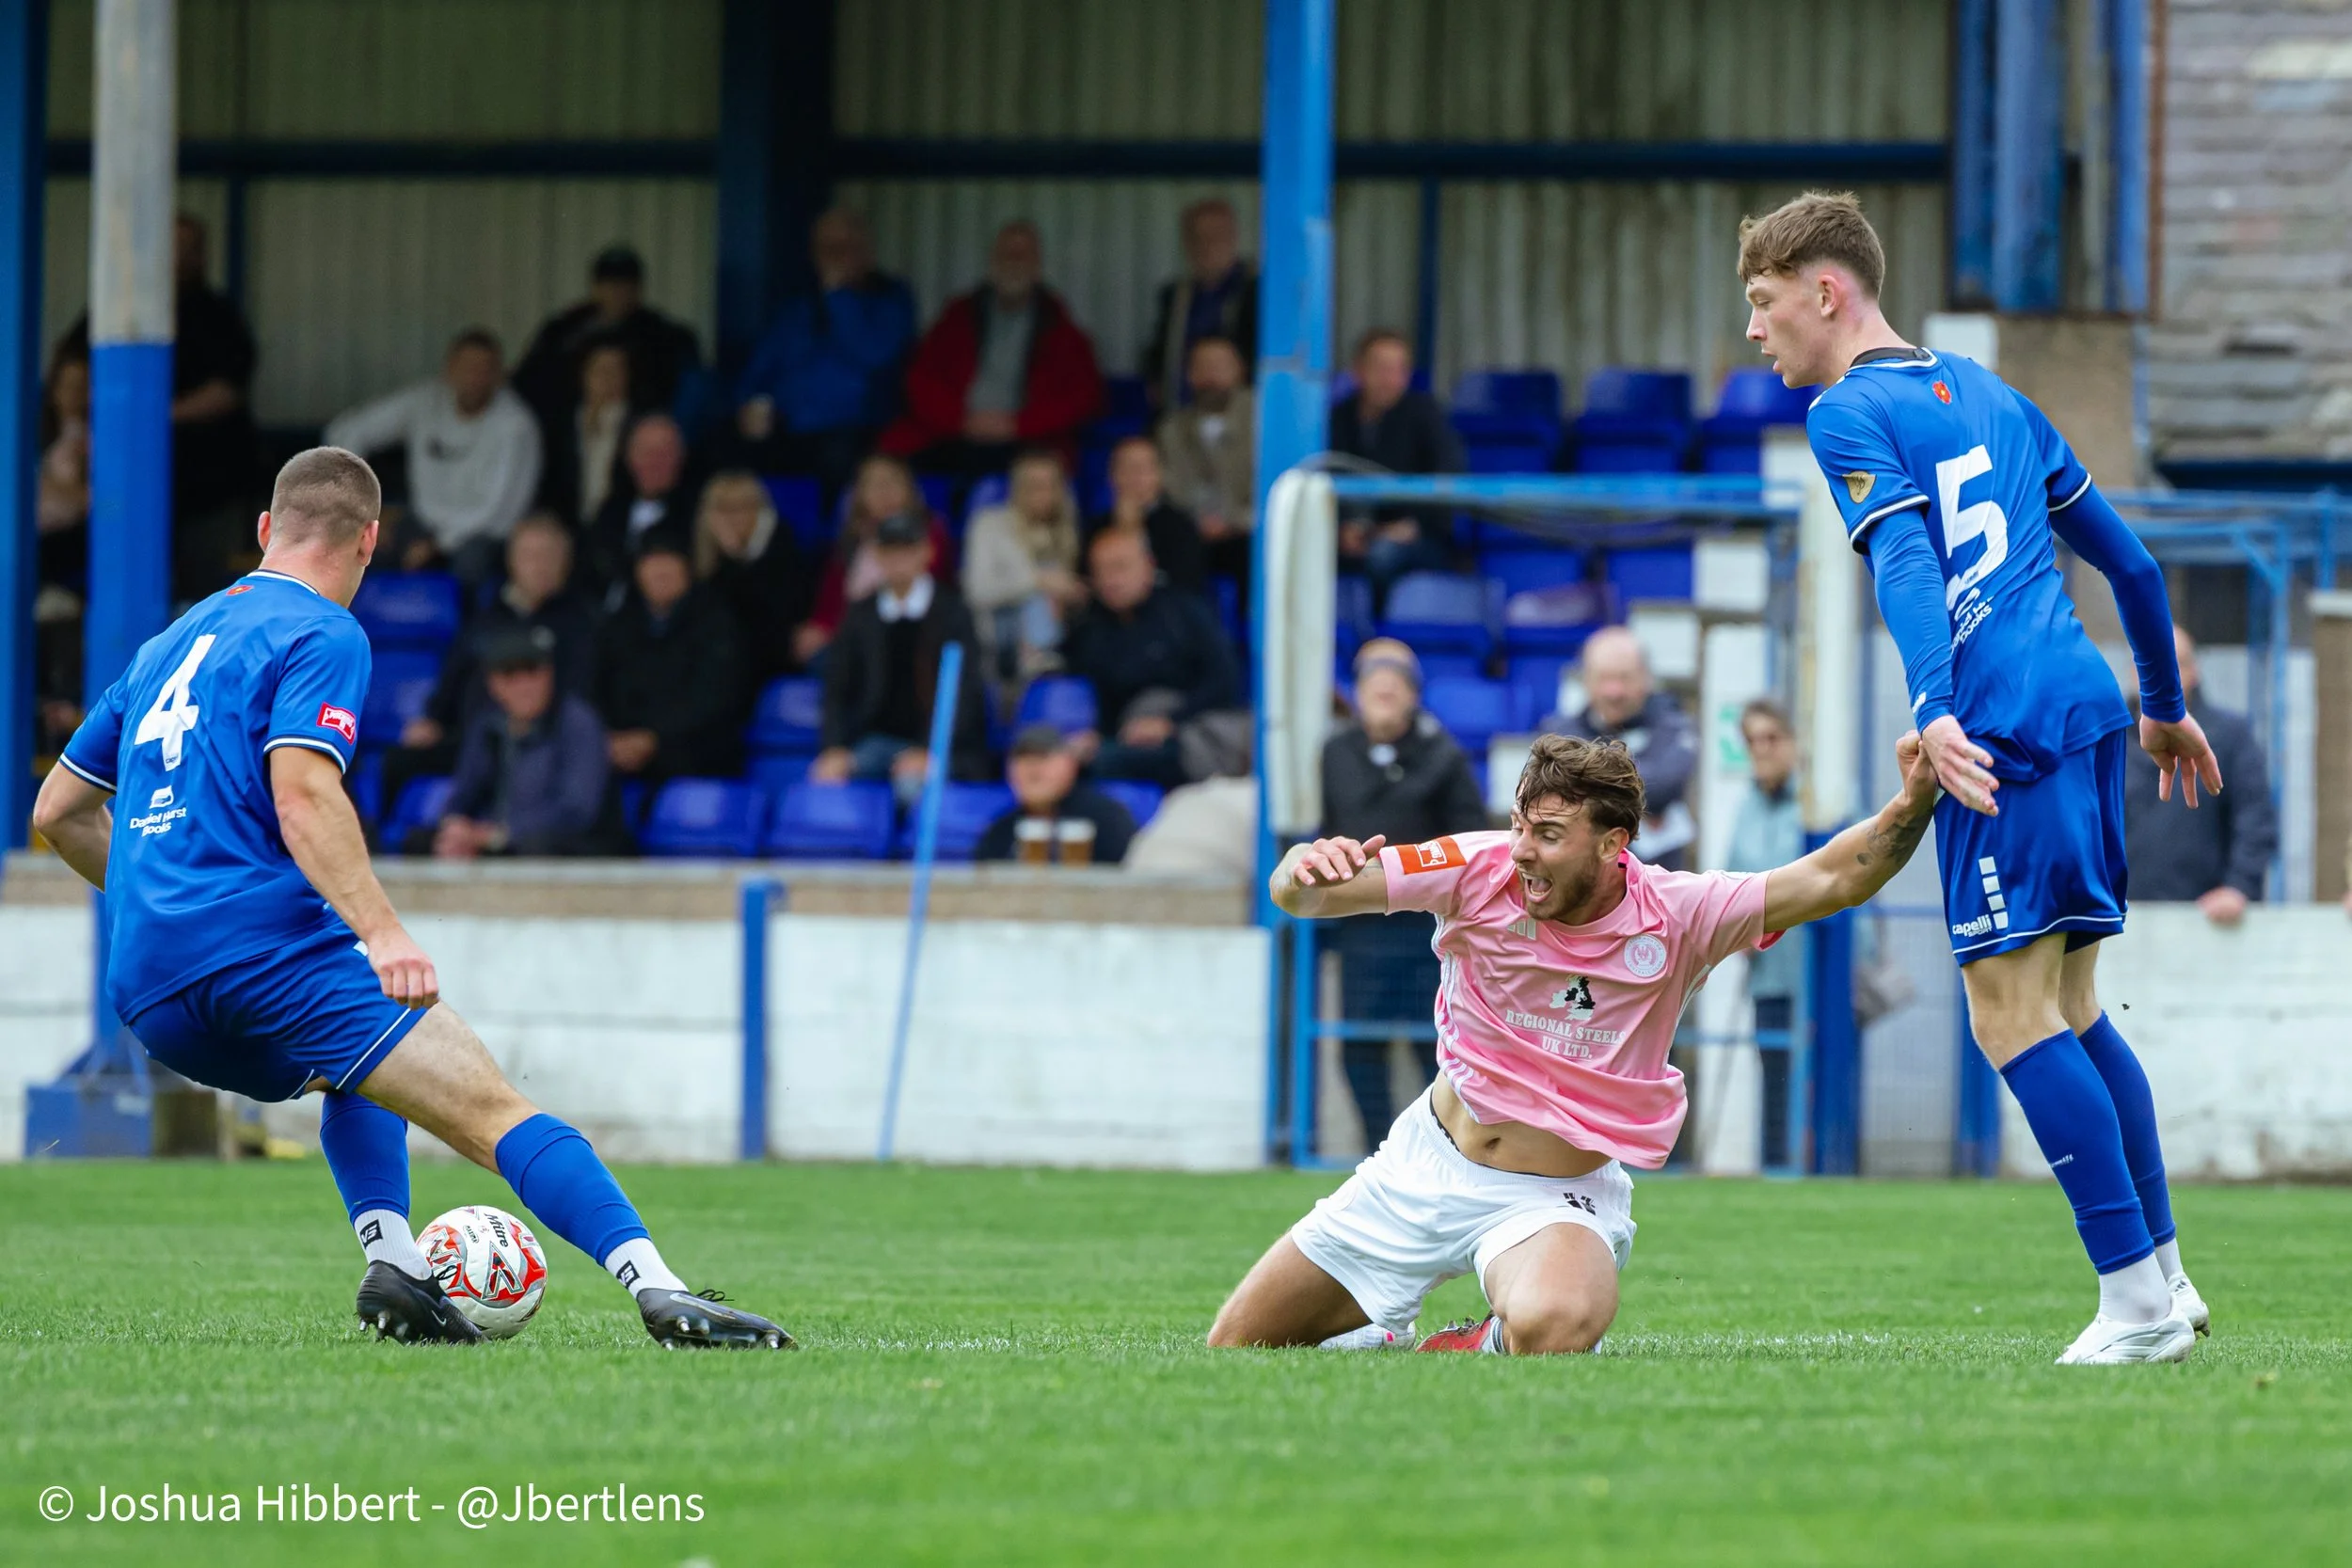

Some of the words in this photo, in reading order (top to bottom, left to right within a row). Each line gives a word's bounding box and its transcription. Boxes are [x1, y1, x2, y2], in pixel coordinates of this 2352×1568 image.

[1935, 444, 2009, 611] 5
[135, 634, 216, 772] 4
[1952, 913, 1992, 937] capelli
[1505, 1009, 1572, 1037] REGIONAL
[1575, 1026, 1627, 1044] STEELS
[1542, 1036, 1561, 1054] UK
[1563, 1042, 1593, 1059] LTD.
[484, 1212, 509, 1248] Mitre
